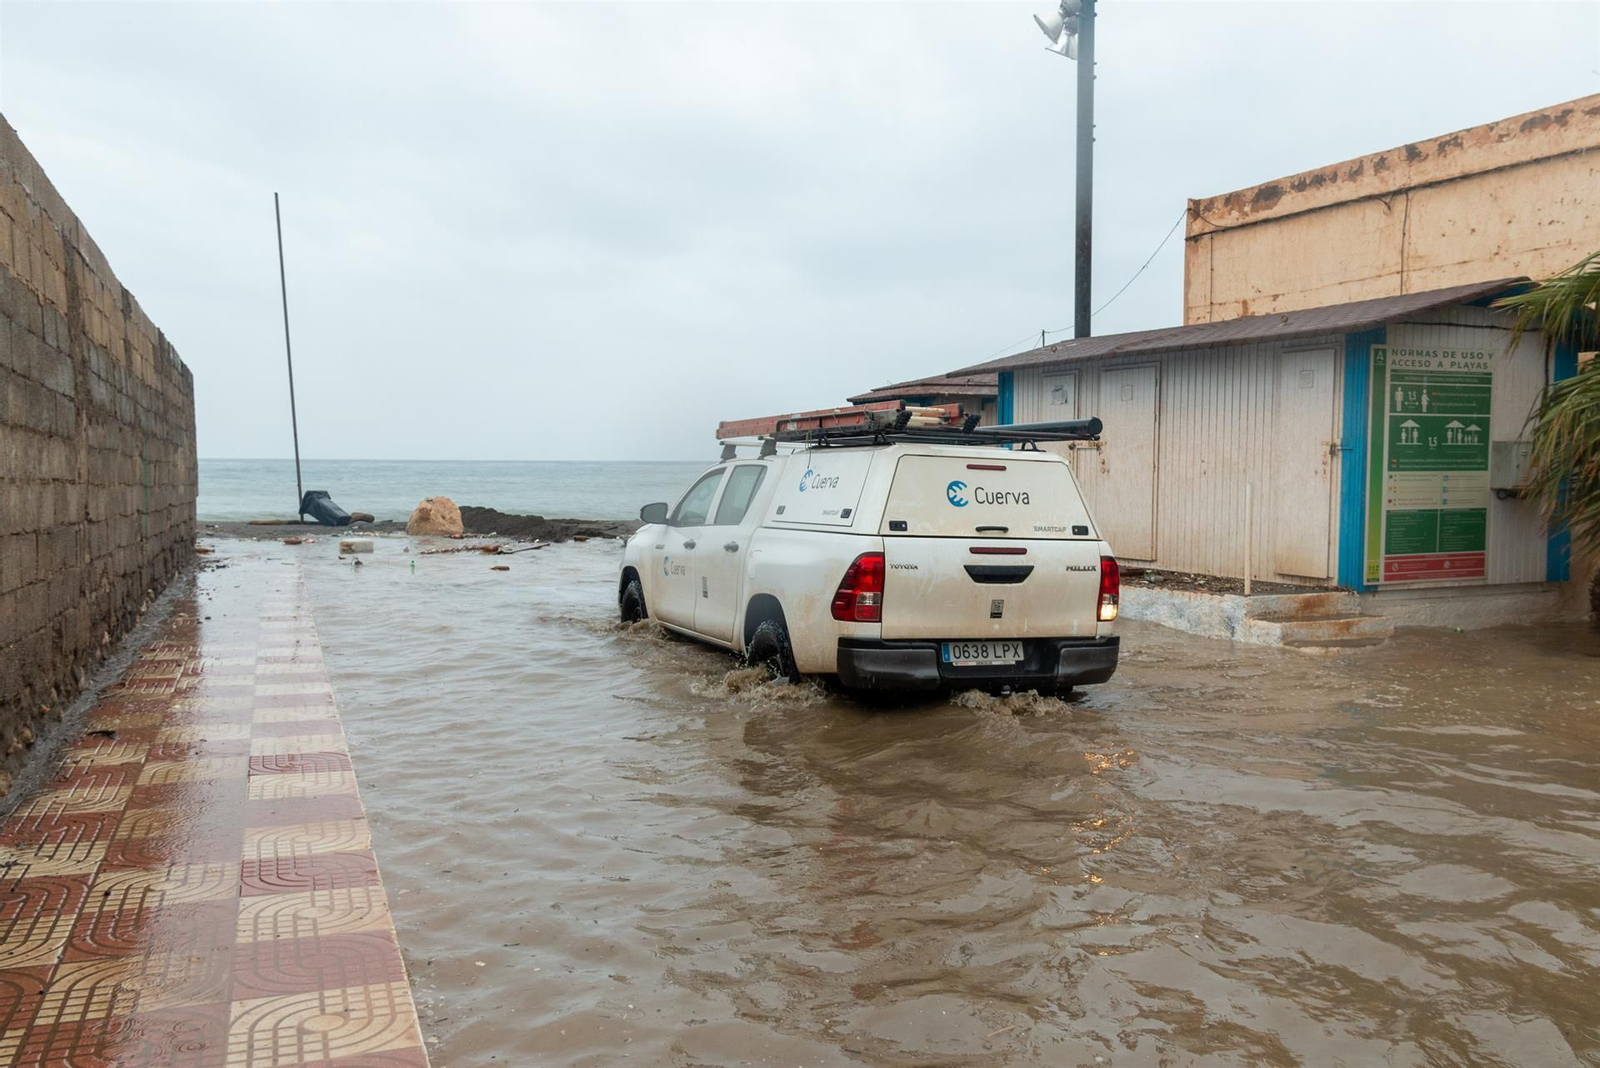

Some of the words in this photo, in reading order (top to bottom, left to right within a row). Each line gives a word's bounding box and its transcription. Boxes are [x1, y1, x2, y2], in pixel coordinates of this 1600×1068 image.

[1391, 348, 1438, 358] NORMAS
[1442, 350, 1457, 359] DE
[1461, 351, 1484, 360] USO
[1488, 352, 1494, 360] Y
[1390, 359, 1431, 368] ACCESO
[1450, 361, 1489, 370] PLAYAS
[811, 473, 840, 489] Cuerva
[974, 486, 1030, 505] Cuerva
[1033, 525, 1067, 533] SMARTCAP
[952, 643, 989, 659] 0638
[992, 643, 1021, 659] LPX
